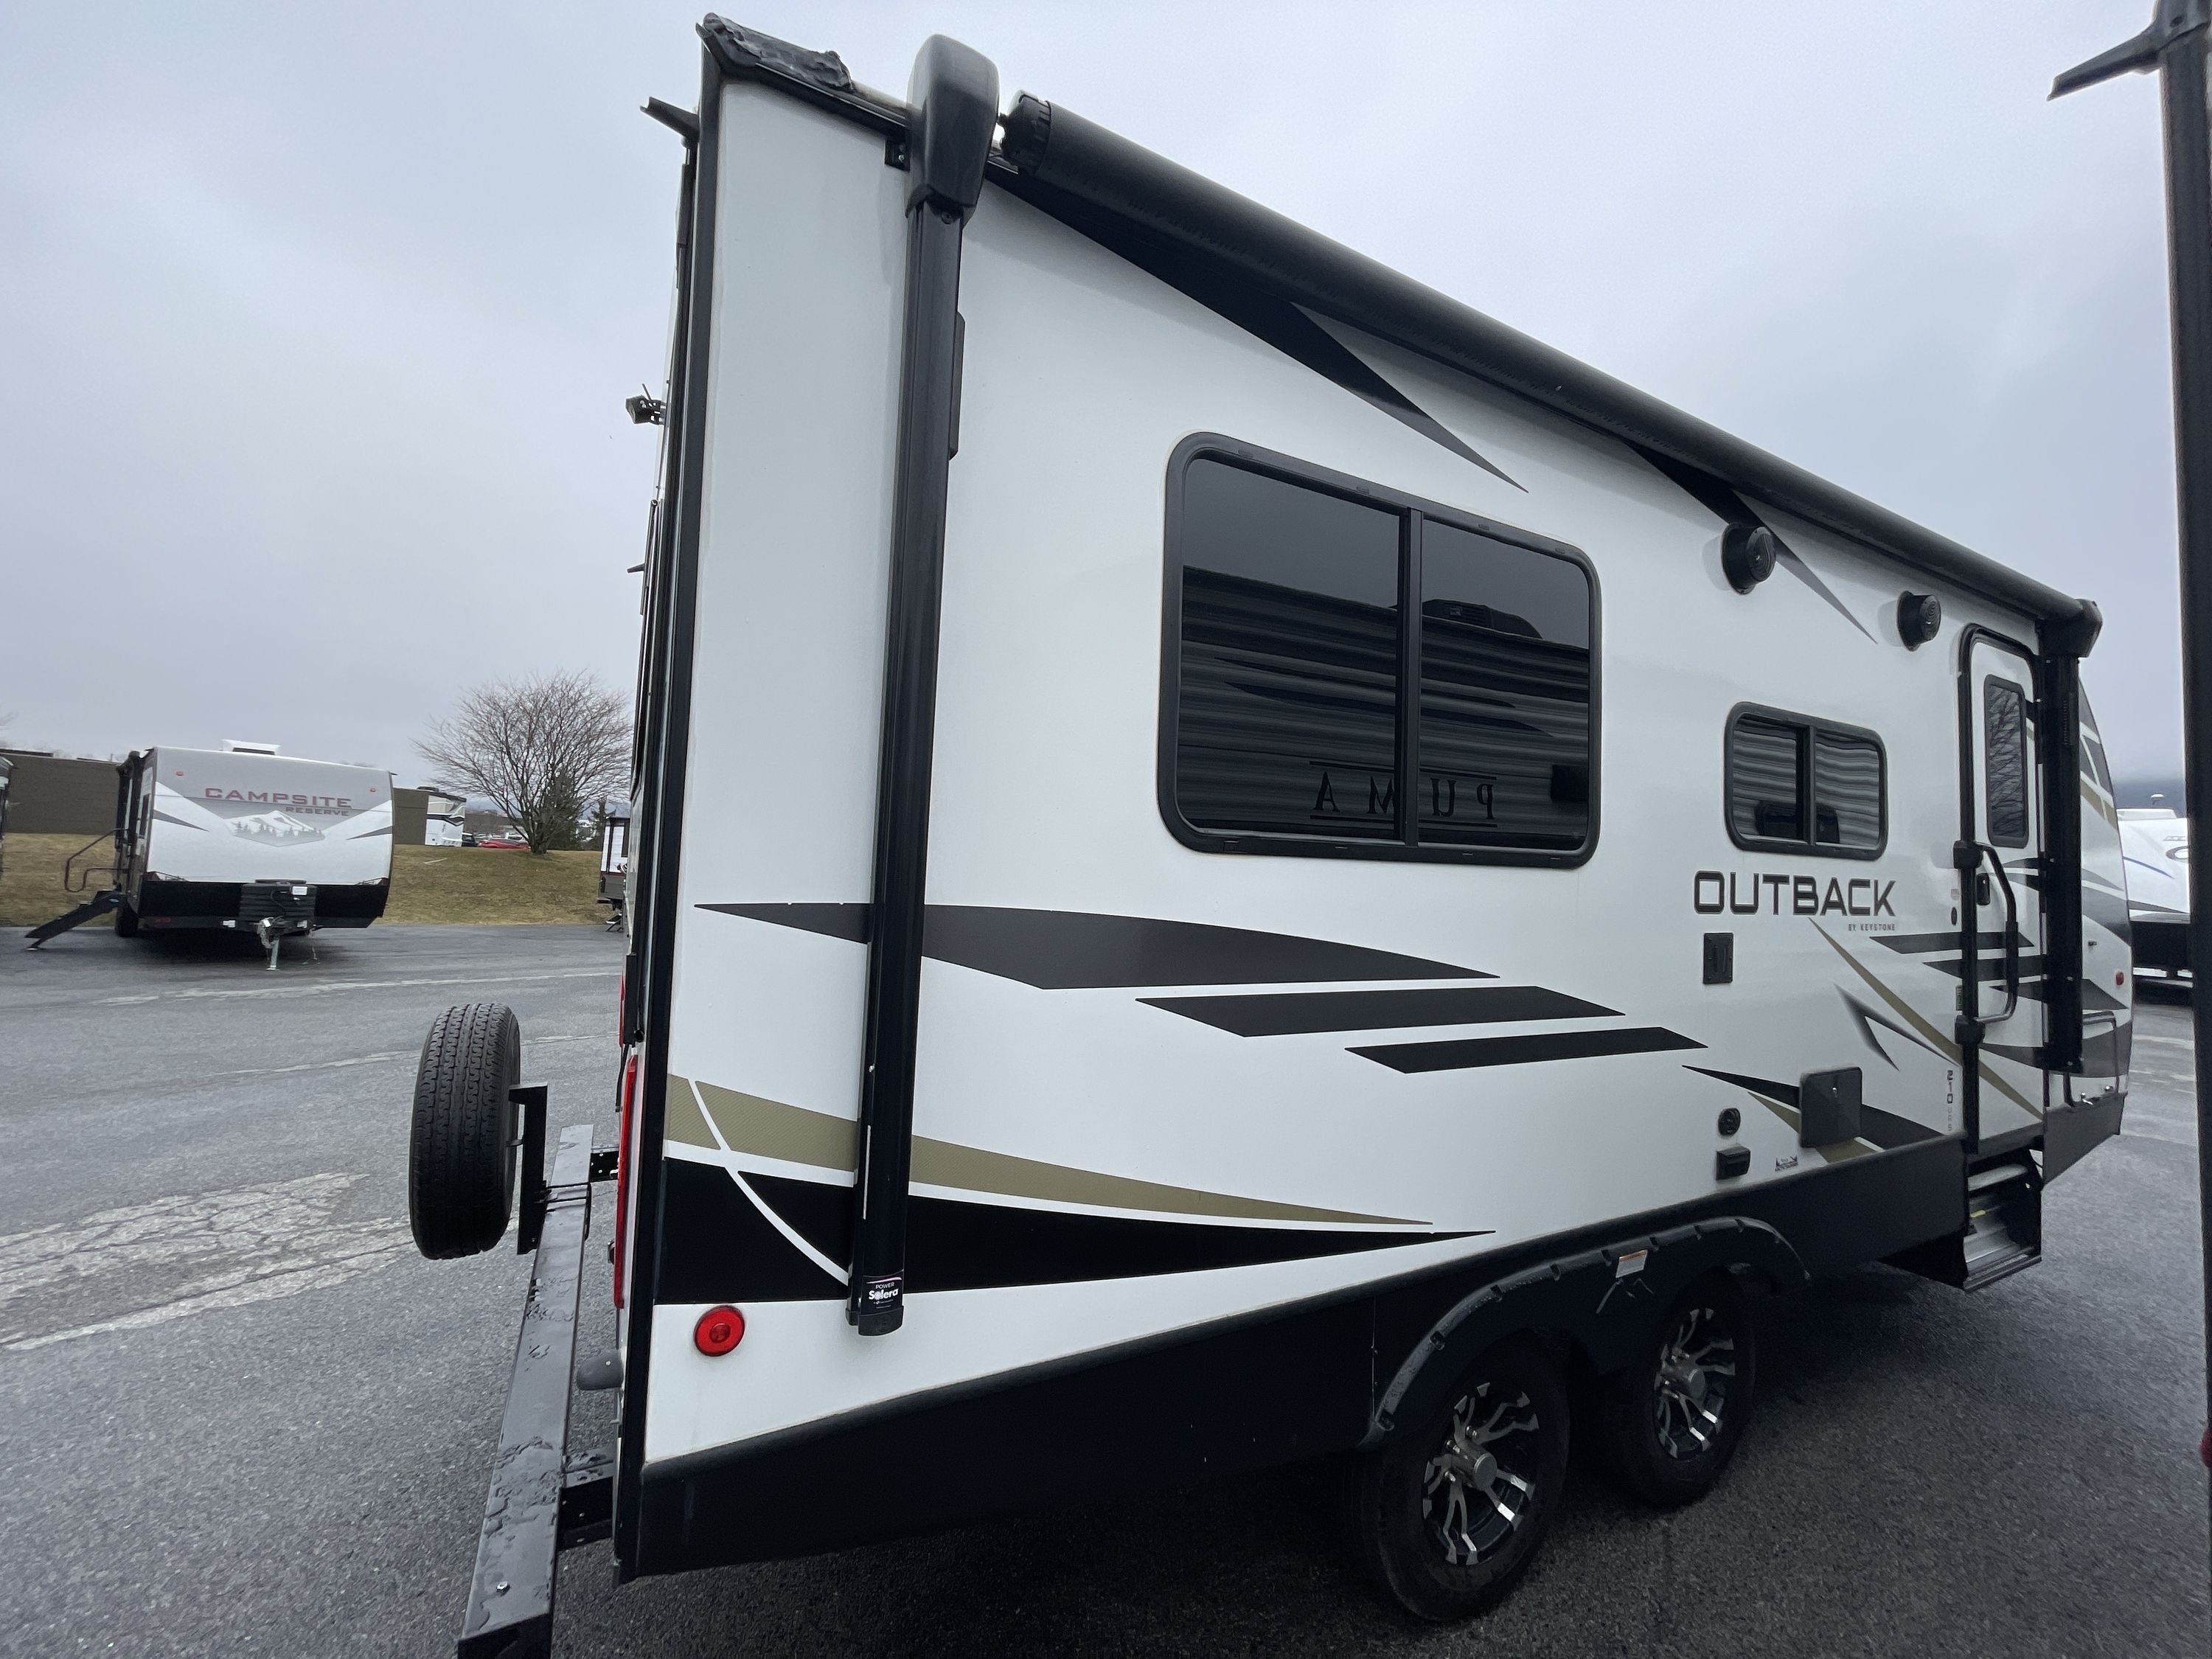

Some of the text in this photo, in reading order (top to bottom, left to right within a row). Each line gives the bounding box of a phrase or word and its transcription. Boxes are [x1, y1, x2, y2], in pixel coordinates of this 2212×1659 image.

[205, 787, 352, 809] CAMPSITE
[285, 807, 349, 816] RESERVE
[1694, 870, 1897, 917] OUTBACK
[1848, 923, 1896, 931] BY KEYSTONE
[869, 1288, 899, 1300] Solera
